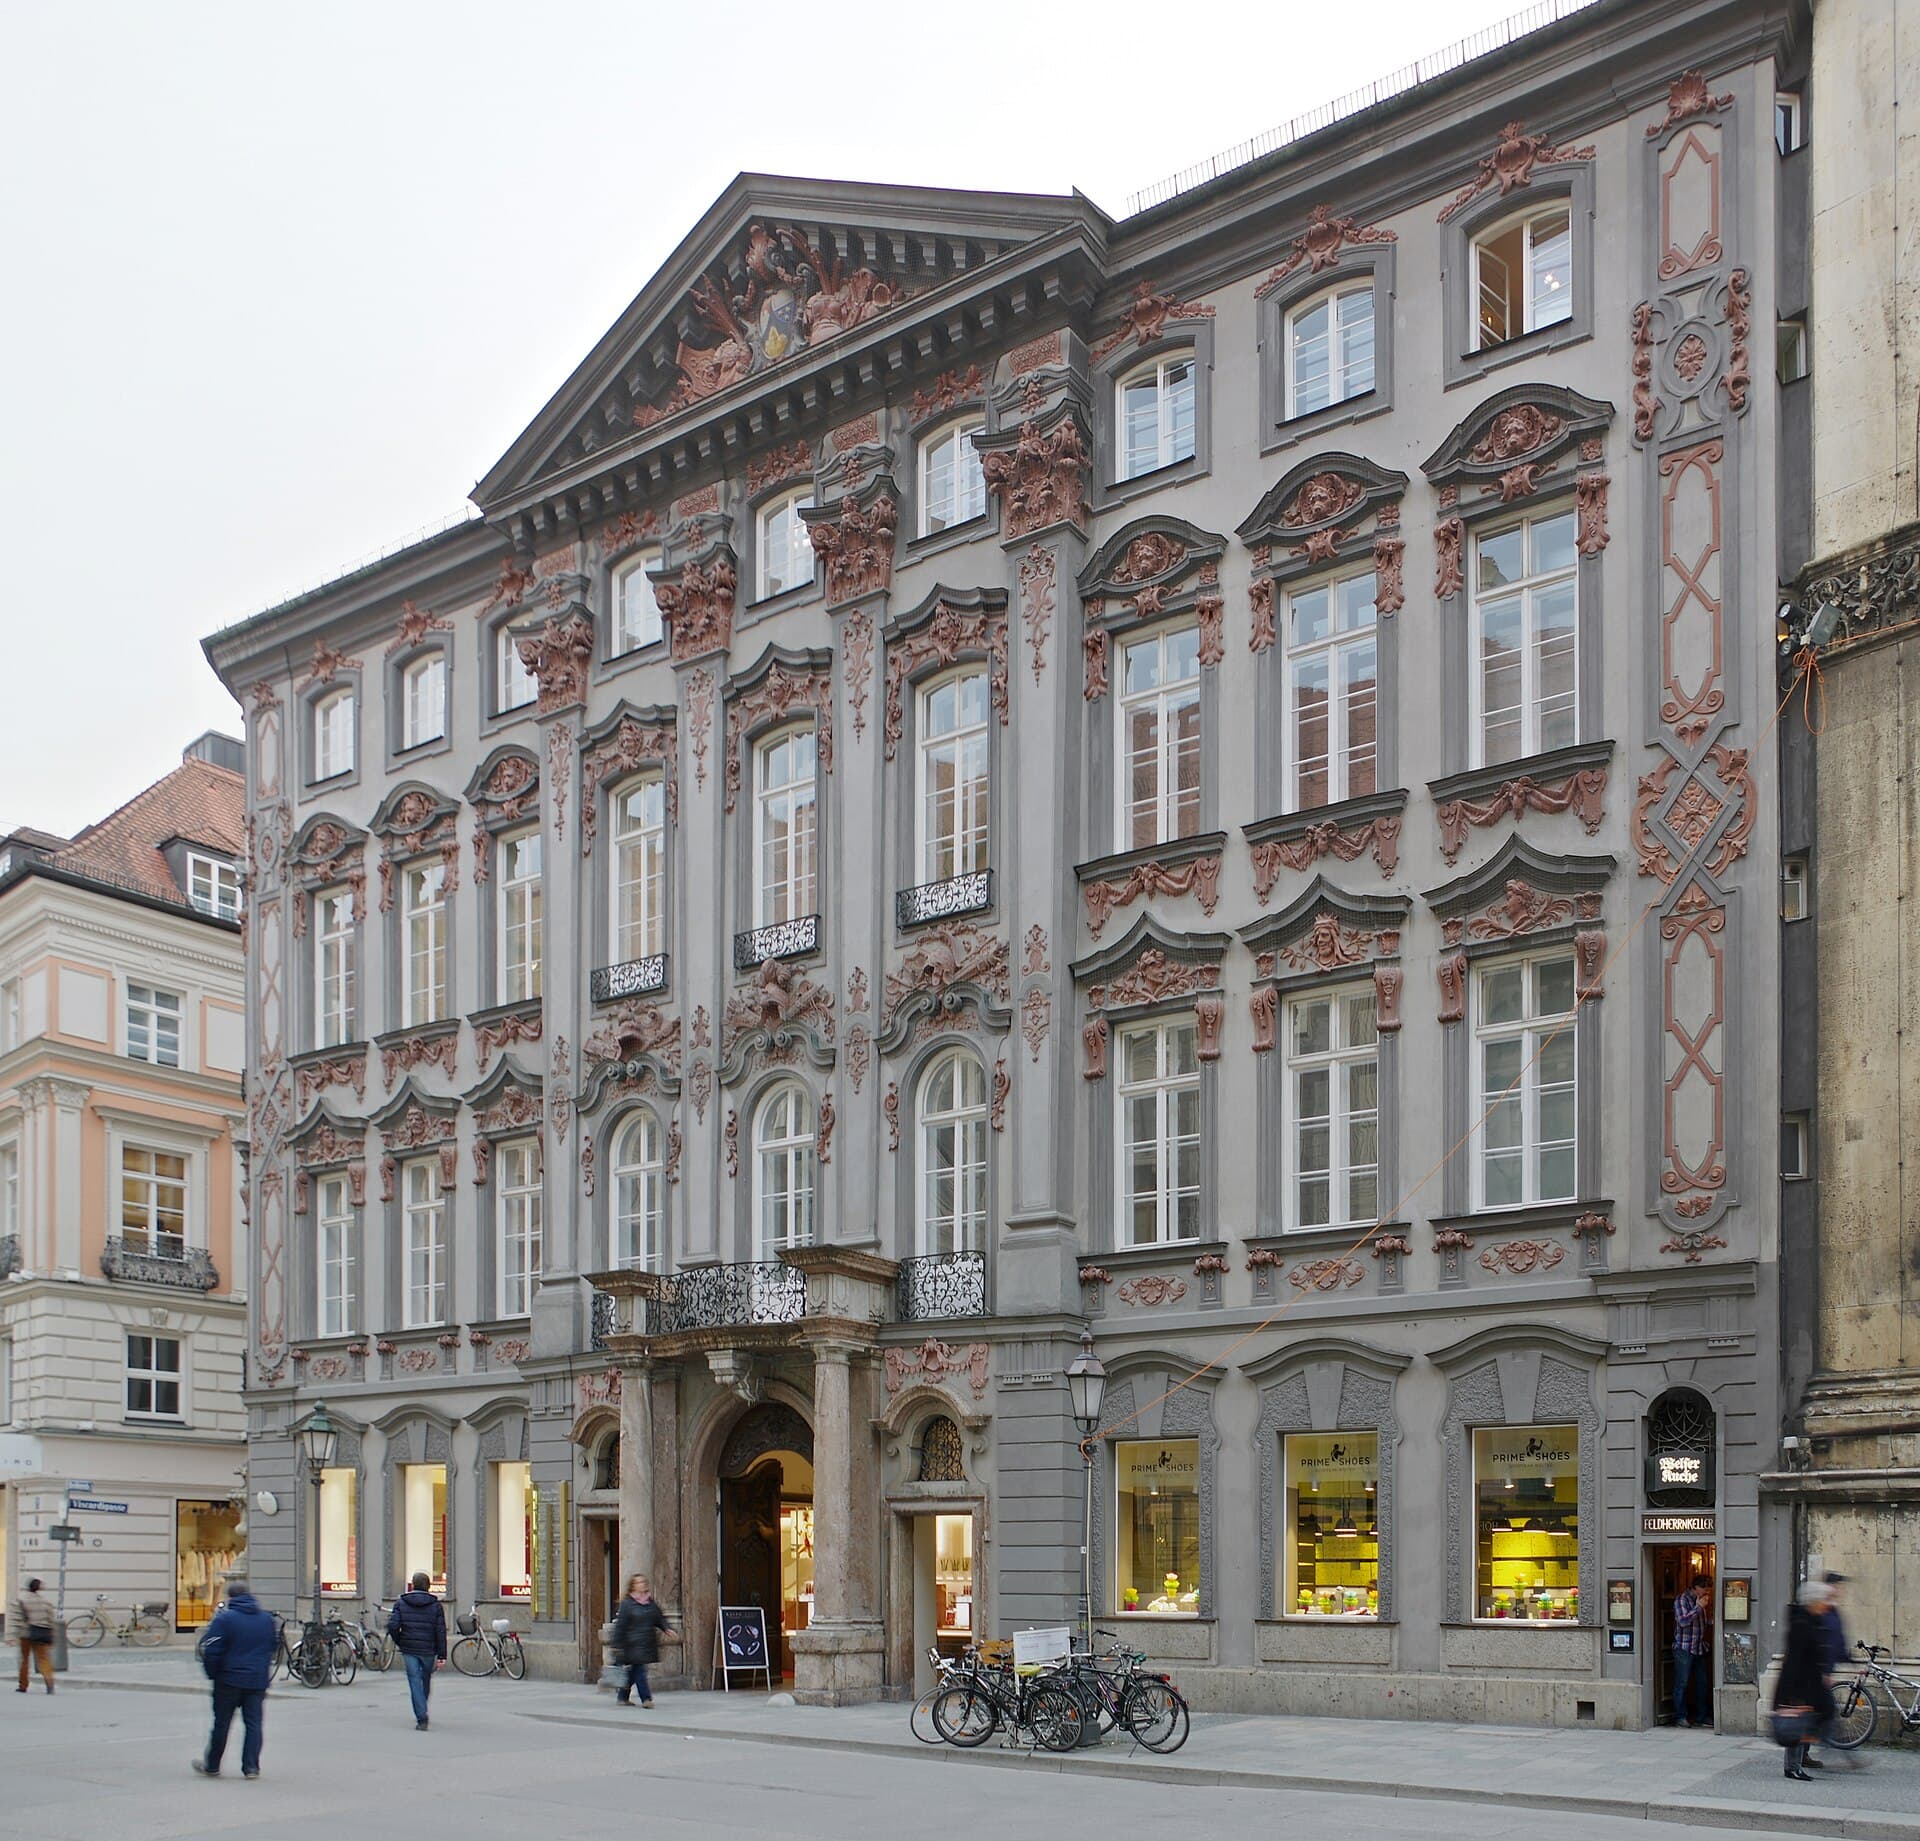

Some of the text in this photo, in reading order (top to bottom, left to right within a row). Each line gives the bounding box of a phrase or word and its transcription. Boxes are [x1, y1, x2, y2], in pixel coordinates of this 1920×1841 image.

[1301, 1456, 1370, 1467] PRIME SHOES
[1492, 1451, 1570, 1463] PRIME SHOES
[1131, 1463, 1194, 1473] PRIME SHOES
[1643, 1518, 1714, 1530] FELDHERRNKELLER
[511, 1586, 531, 1595] CLAR
